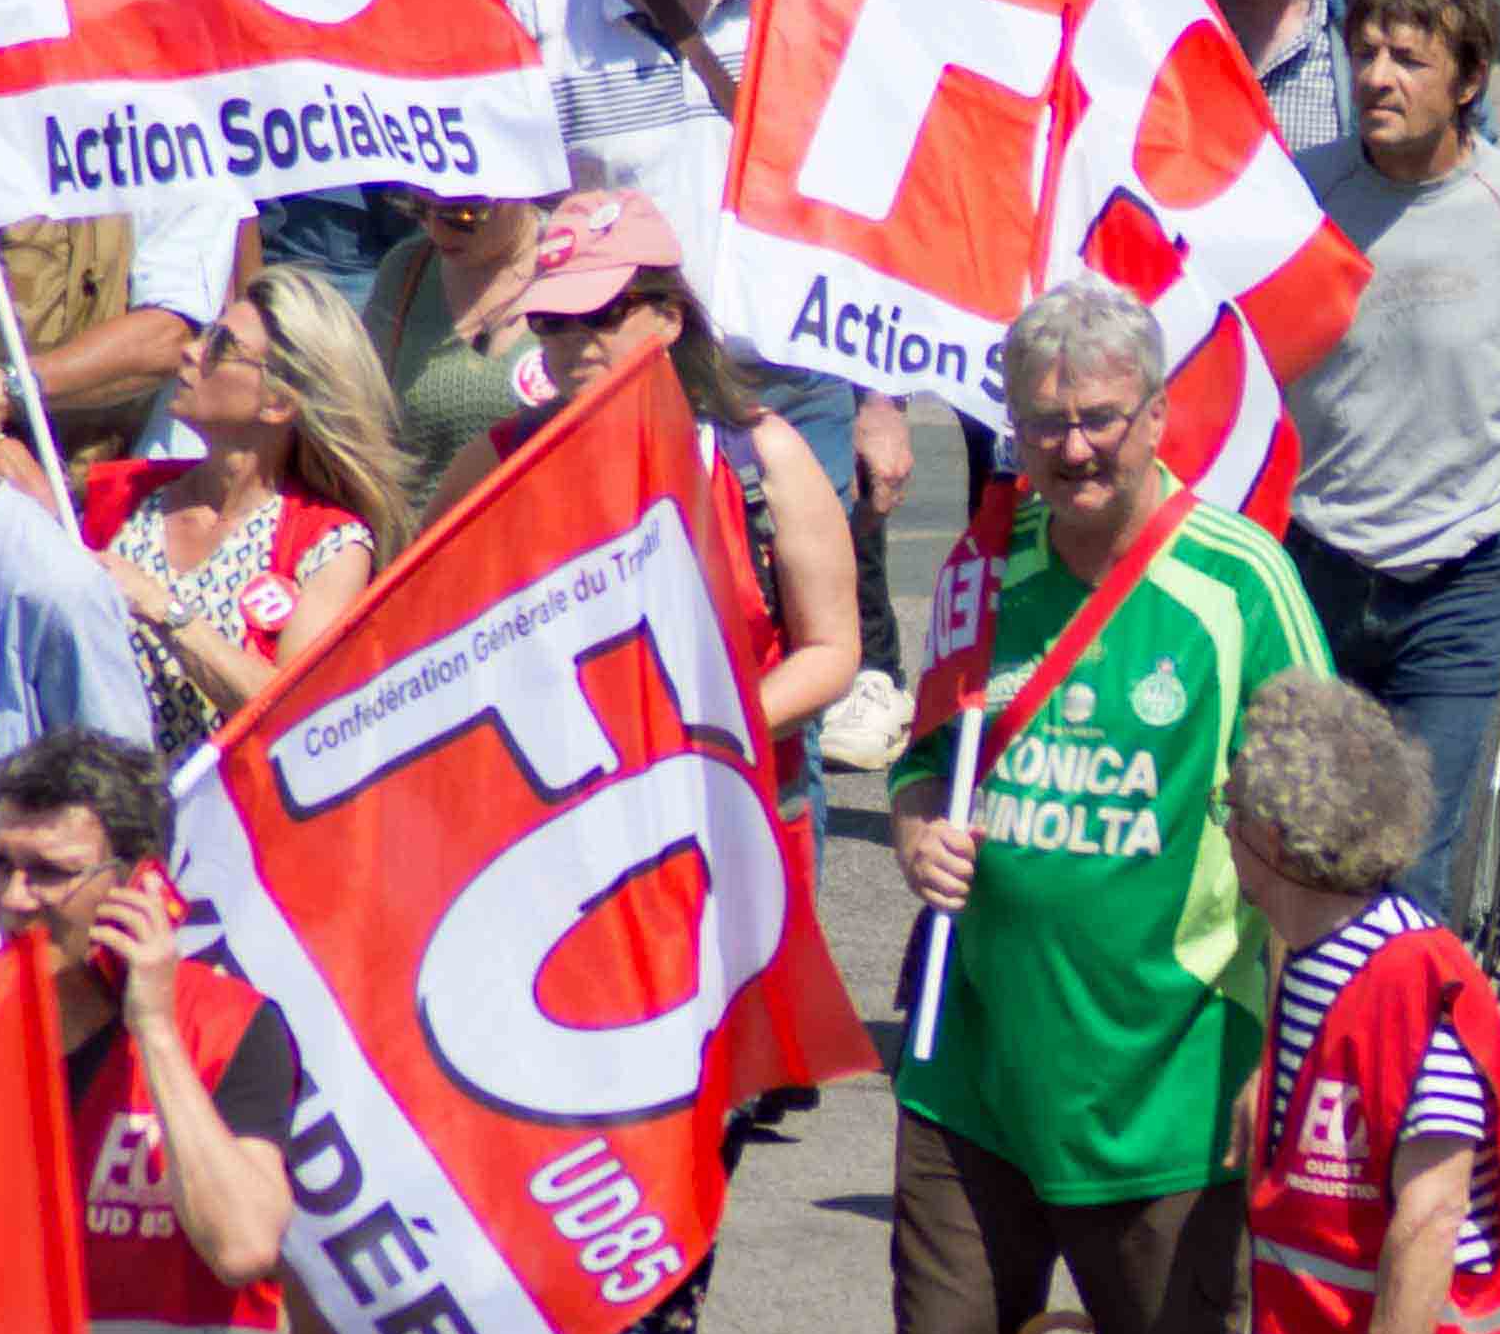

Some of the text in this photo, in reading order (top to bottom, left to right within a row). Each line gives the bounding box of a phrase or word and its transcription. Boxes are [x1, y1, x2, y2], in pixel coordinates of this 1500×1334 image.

[45, 102, 215, 197] Action
[790, 273, 969, 390] Action
[573, 567, 609, 604] du
[267, 495, 791, 1127] FO
[85, 1203, 178, 1239] UD 85
[529, 1133, 689, 1305] UD85
